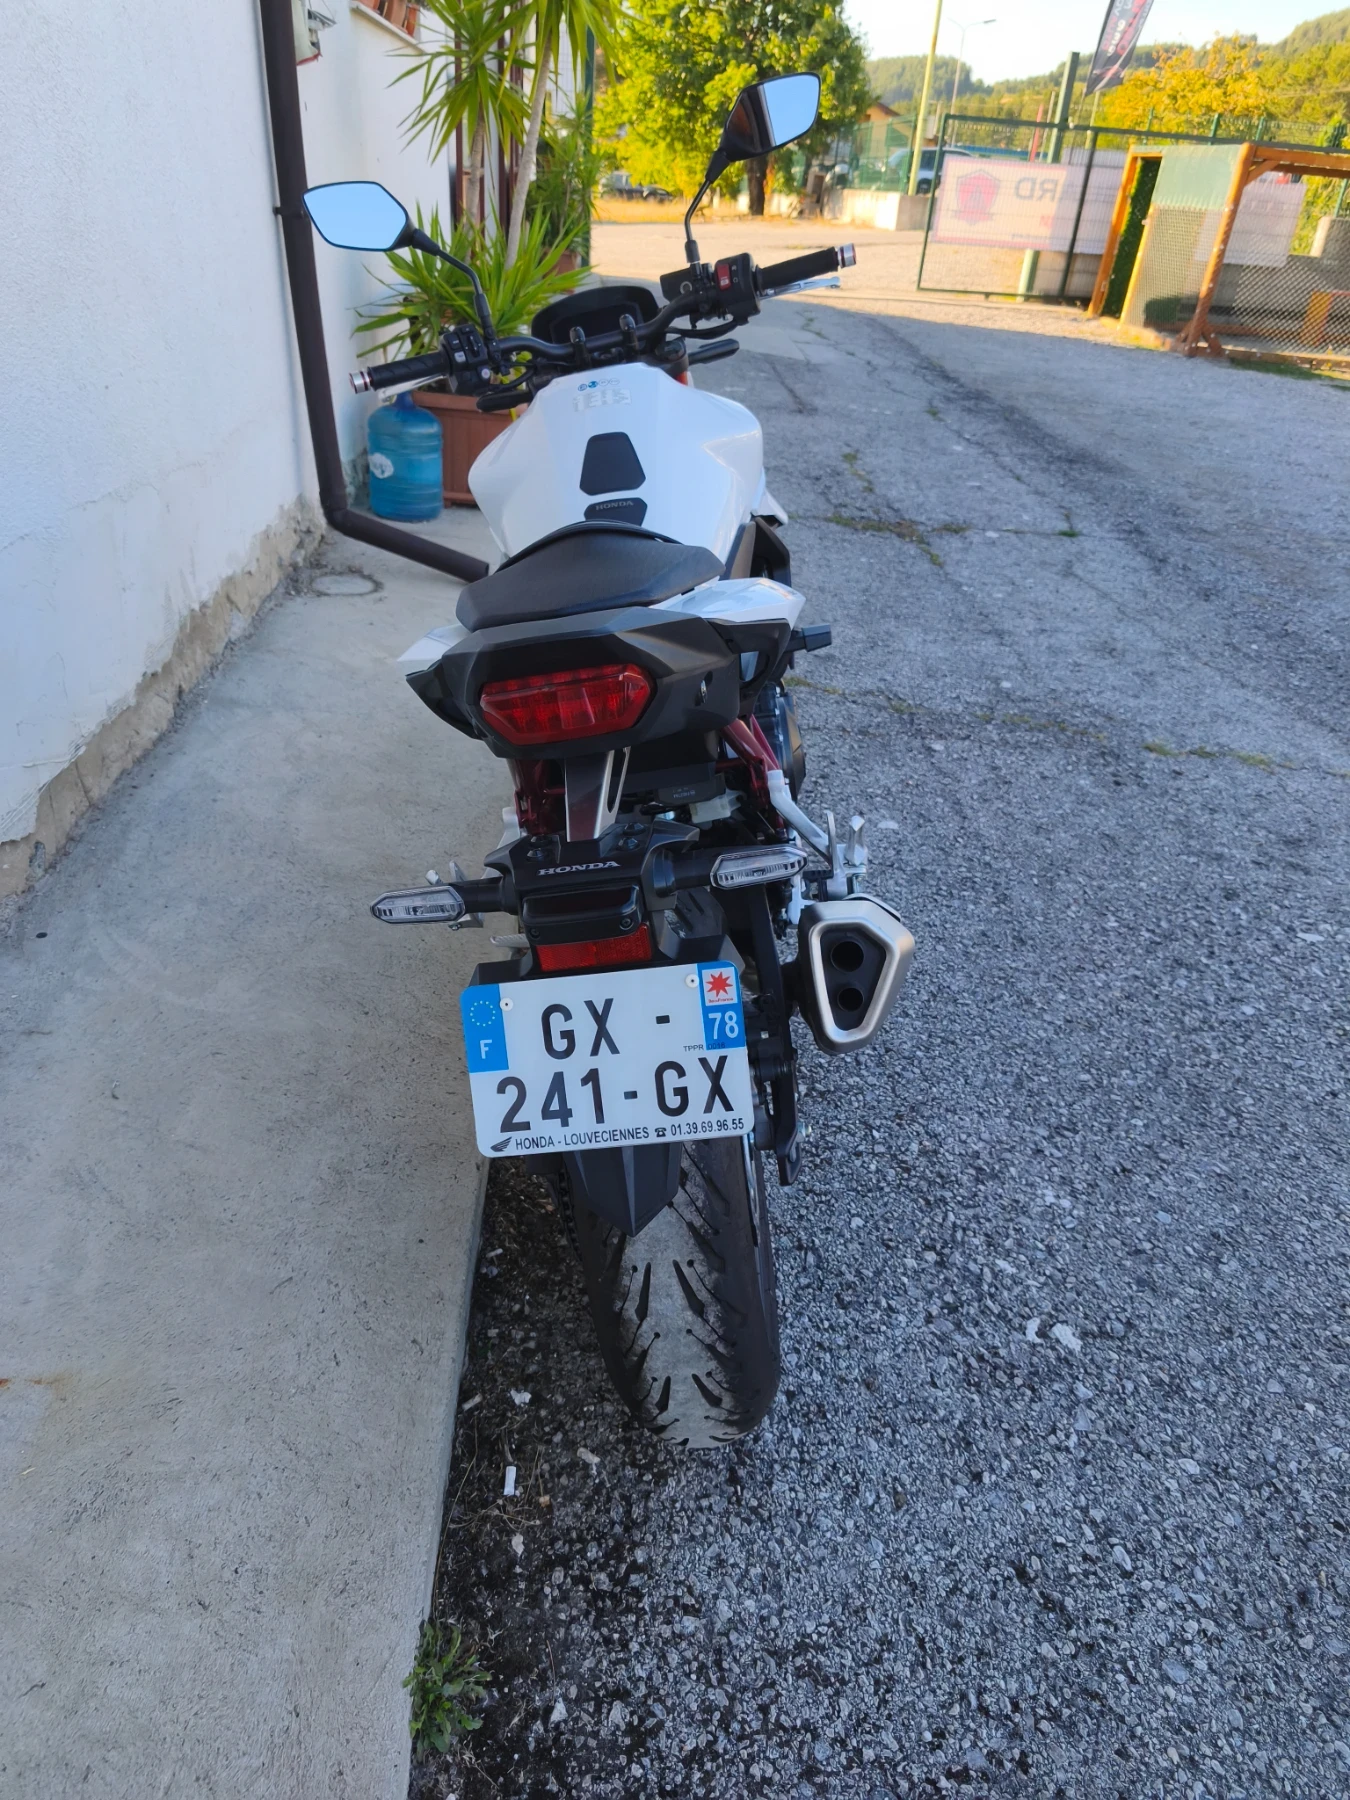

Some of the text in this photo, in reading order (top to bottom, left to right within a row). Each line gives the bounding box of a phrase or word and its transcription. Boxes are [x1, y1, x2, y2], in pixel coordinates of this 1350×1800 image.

[595, 500, 634, 510] HONDA
[538, 860, 621, 876] HONDA
[541, 998, 620, 1060] GX
[708, 1011, 739, 1040] 78
[479, 1039, 492, 1059] F
[683, 1043, 704, 1052] TPPR
[515, 1136, 555, 1150] HONDA
[564, 1127, 650, 1146] LOUVECIENNES
[670, 1118, 744, 1136] 01.39.69.96.55
